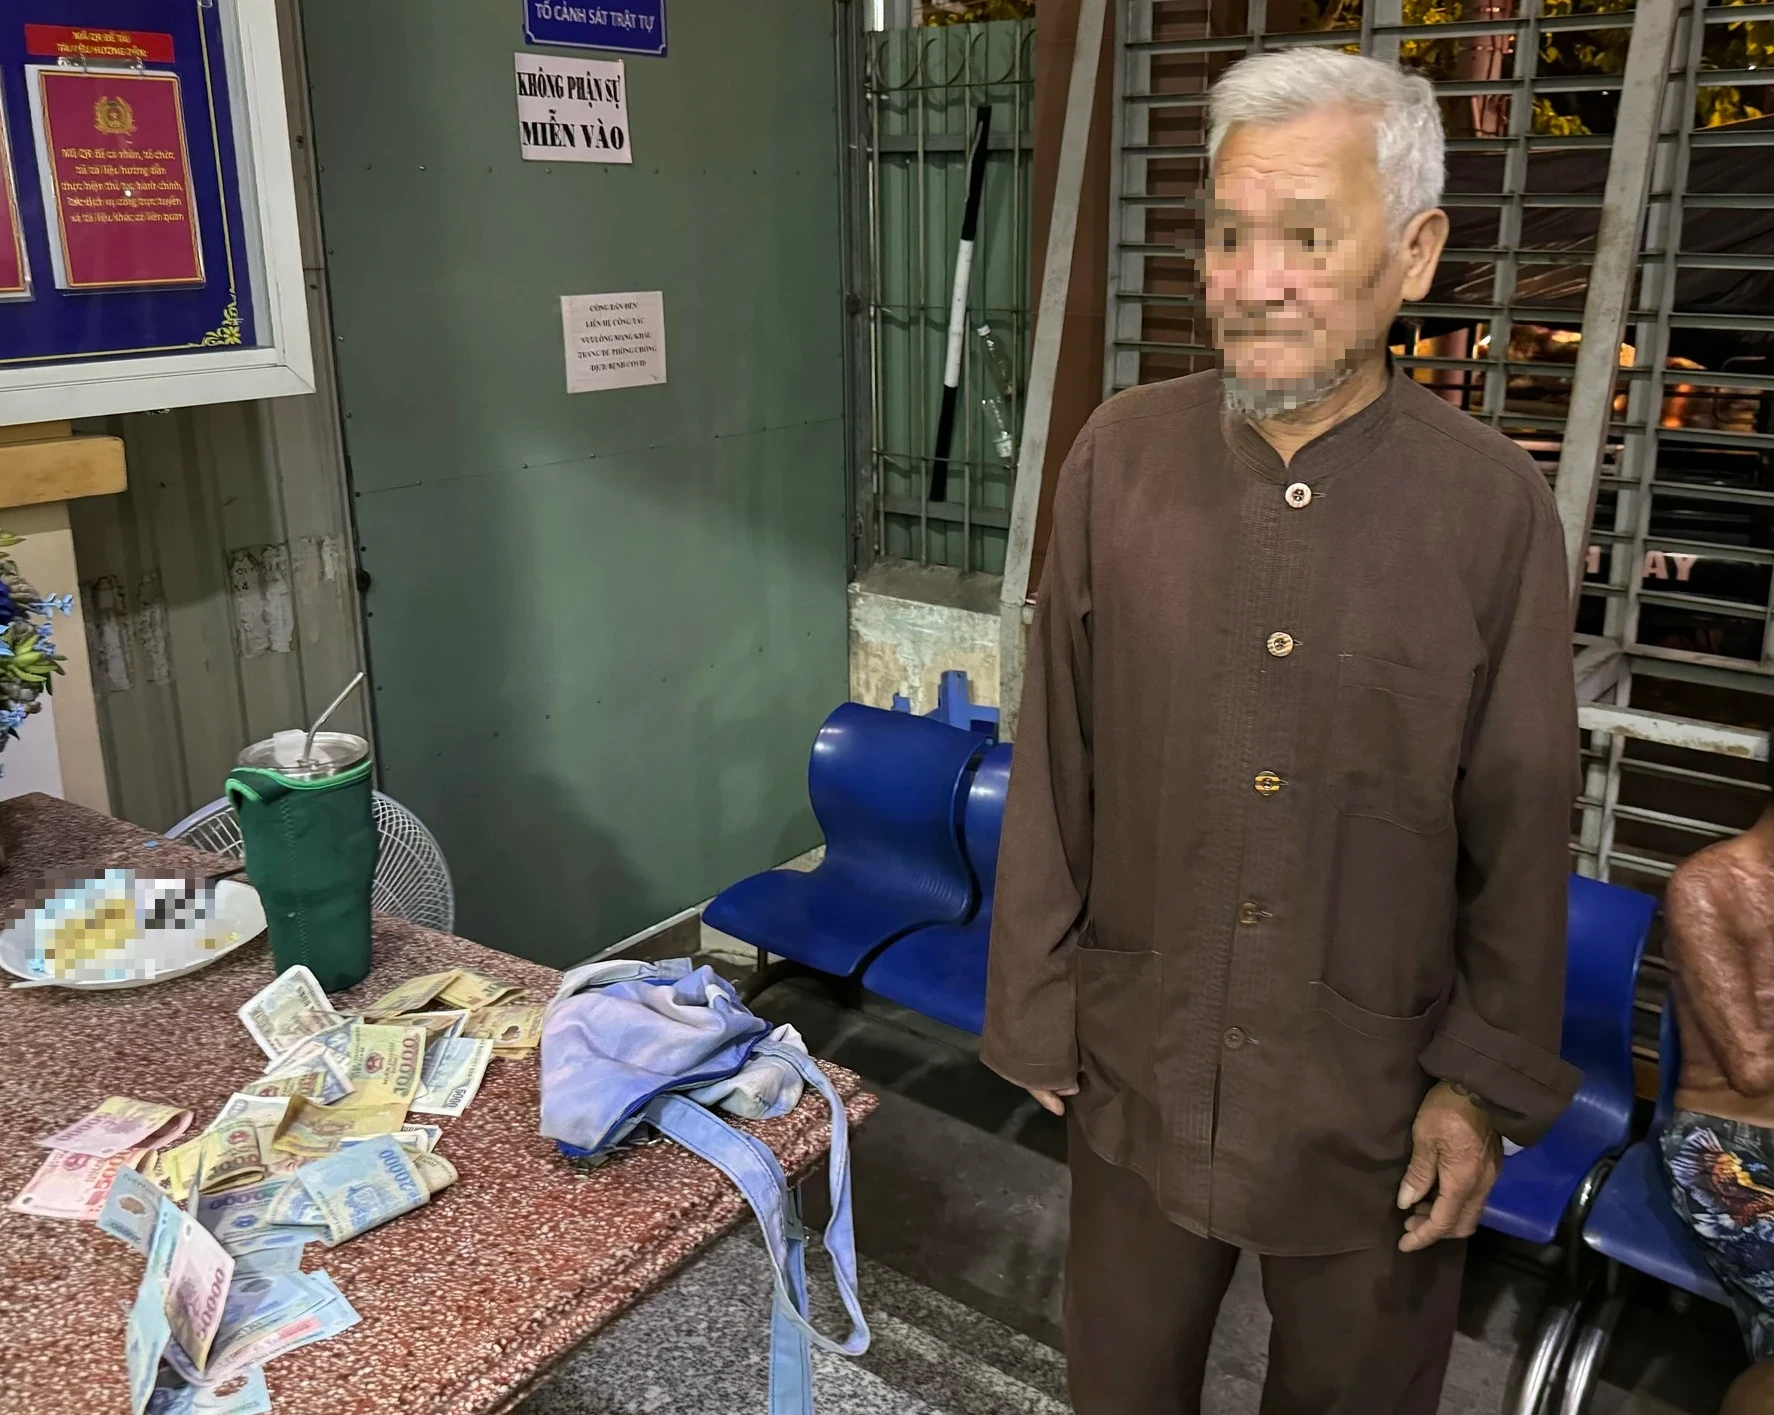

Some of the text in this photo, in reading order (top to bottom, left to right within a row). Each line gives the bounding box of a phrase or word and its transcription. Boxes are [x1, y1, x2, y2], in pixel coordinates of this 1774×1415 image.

[554, 1, 586, 23] CẢNH
[589, 6, 608, 26] SÁT
[610, 10, 636, 30] TRẬT
[638, 15, 655, 32] TỰ
[517, 67, 620, 108] KHÔNG PHẬN SỰ
[521, 109, 624, 150] MIỄN VÀO
